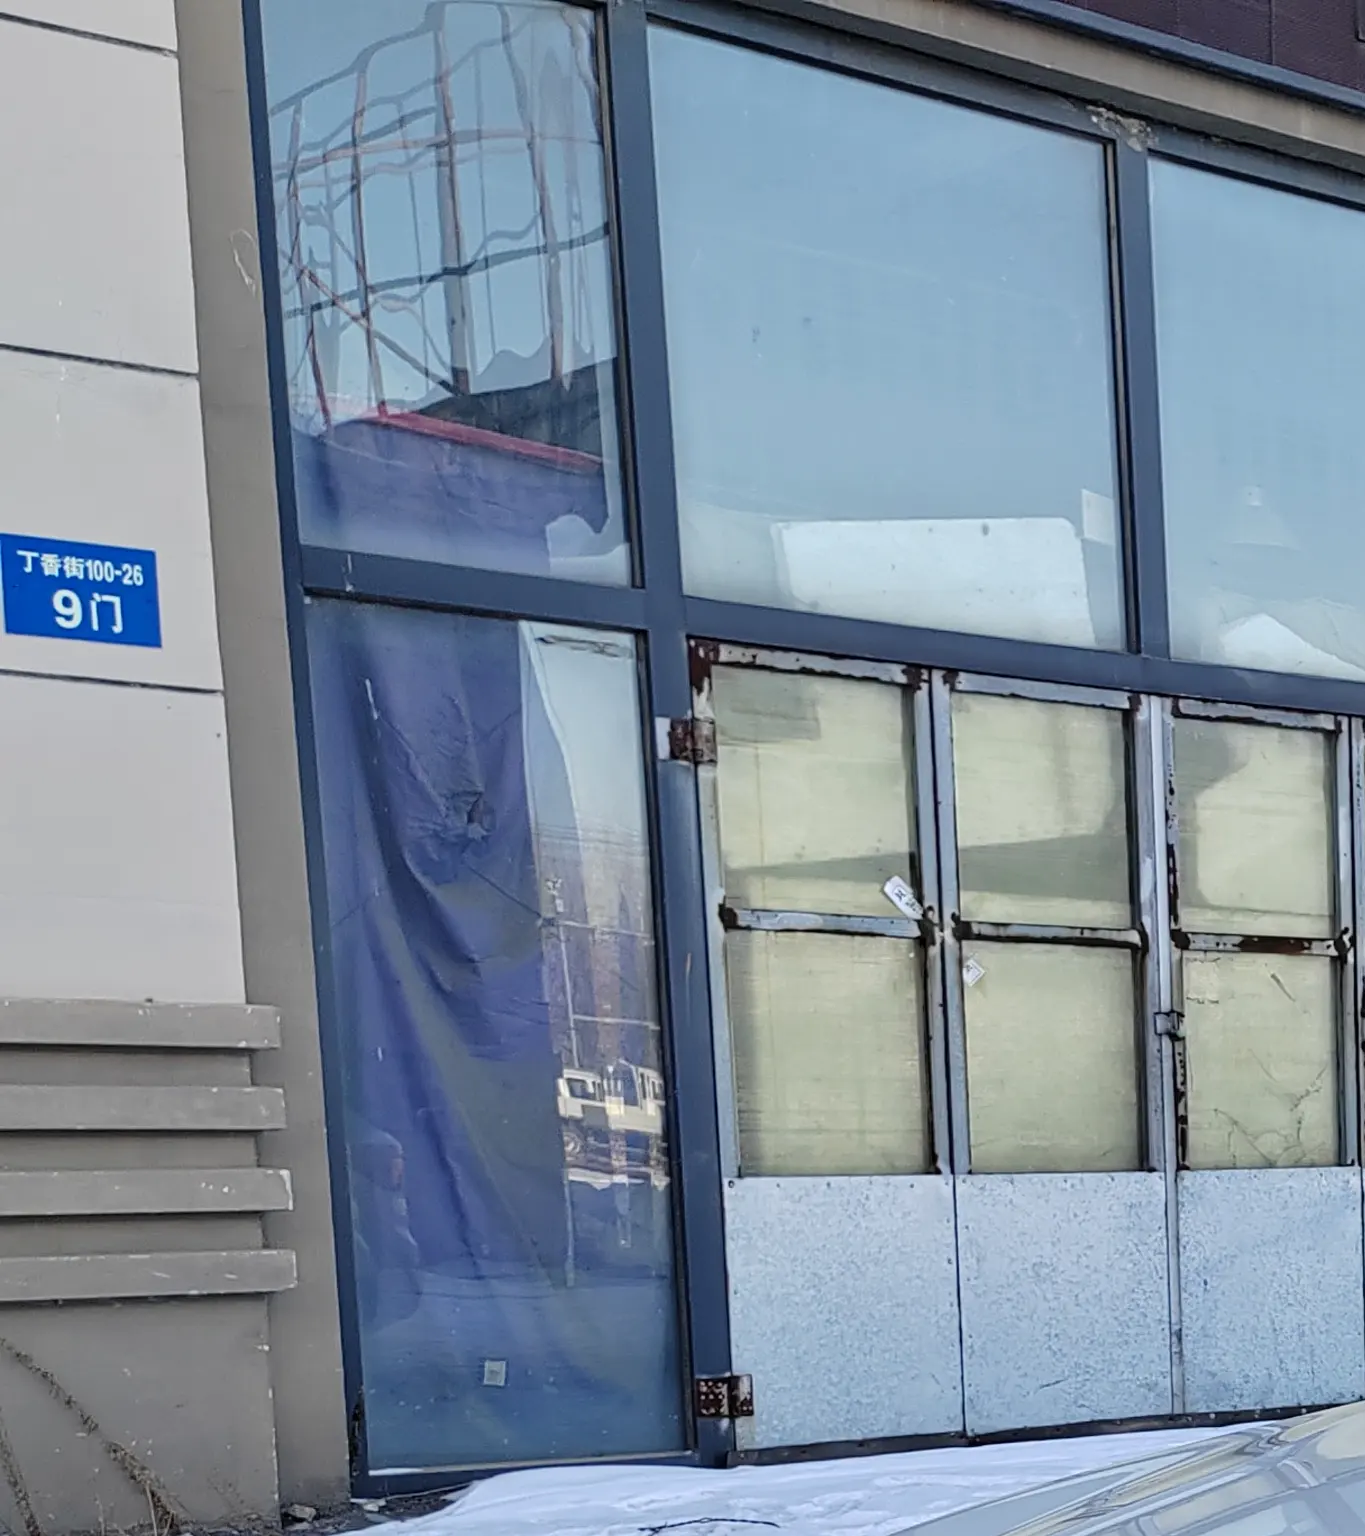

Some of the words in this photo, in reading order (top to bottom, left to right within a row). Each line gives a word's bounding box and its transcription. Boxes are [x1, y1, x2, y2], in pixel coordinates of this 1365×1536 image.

[15, 549, 145, 587] 丁香街100-26
[52, 588, 124, 635] 9门
